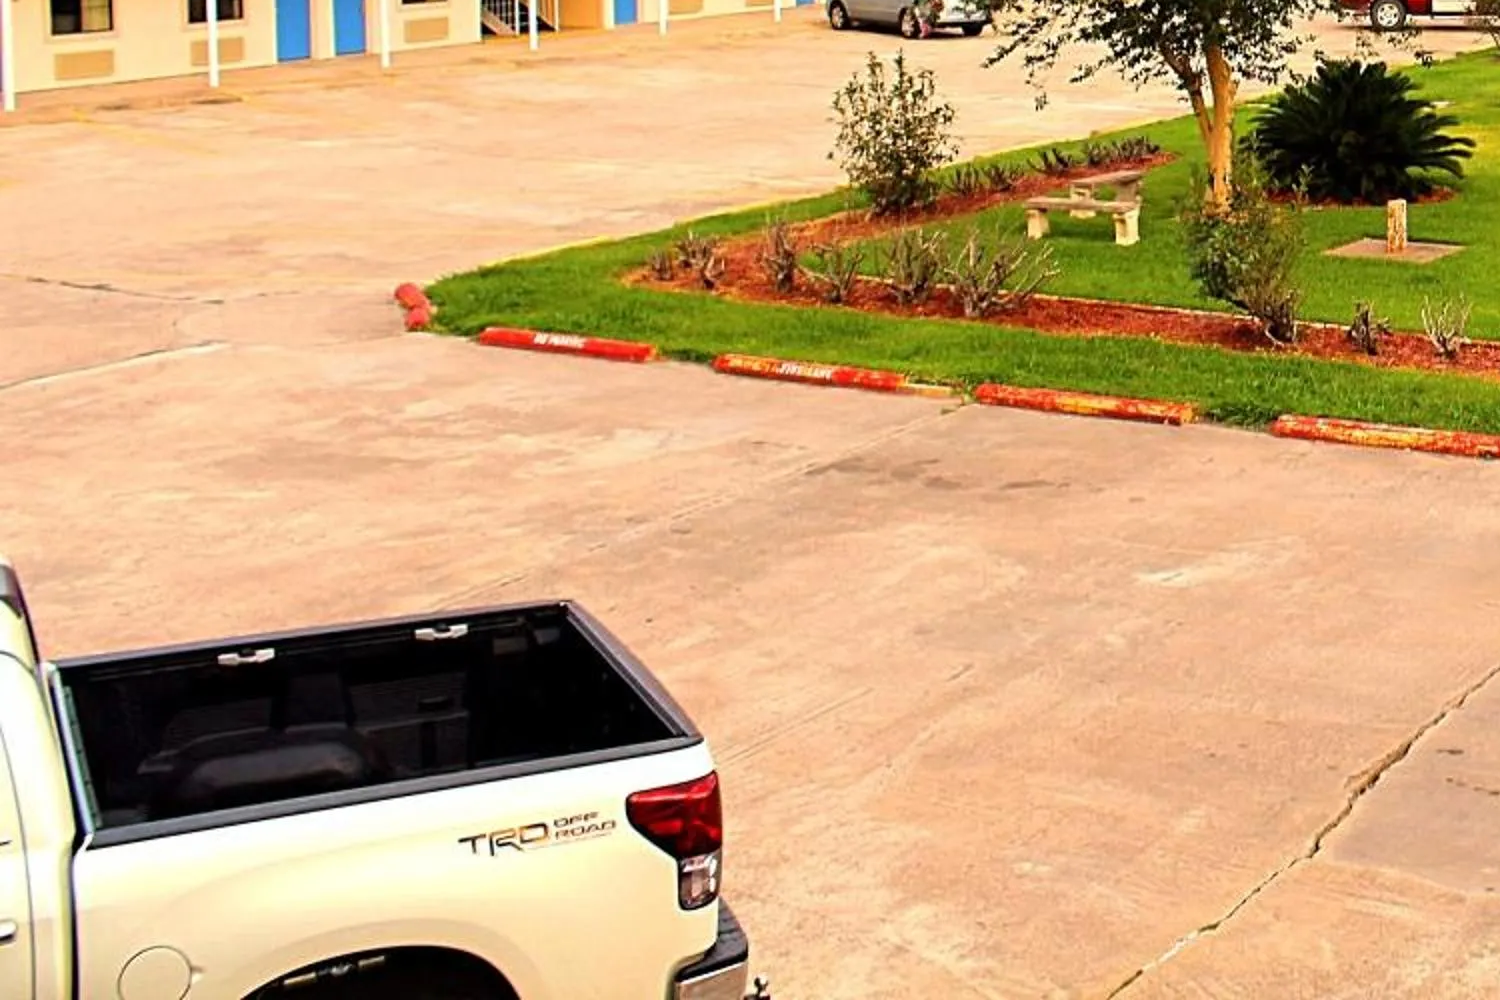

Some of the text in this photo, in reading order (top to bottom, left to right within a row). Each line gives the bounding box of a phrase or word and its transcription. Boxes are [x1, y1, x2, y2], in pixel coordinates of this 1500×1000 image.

[553, 811, 599, 828] OFF
[458, 822, 549, 856] TRD
[555, 820, 616, 840] ROAD
